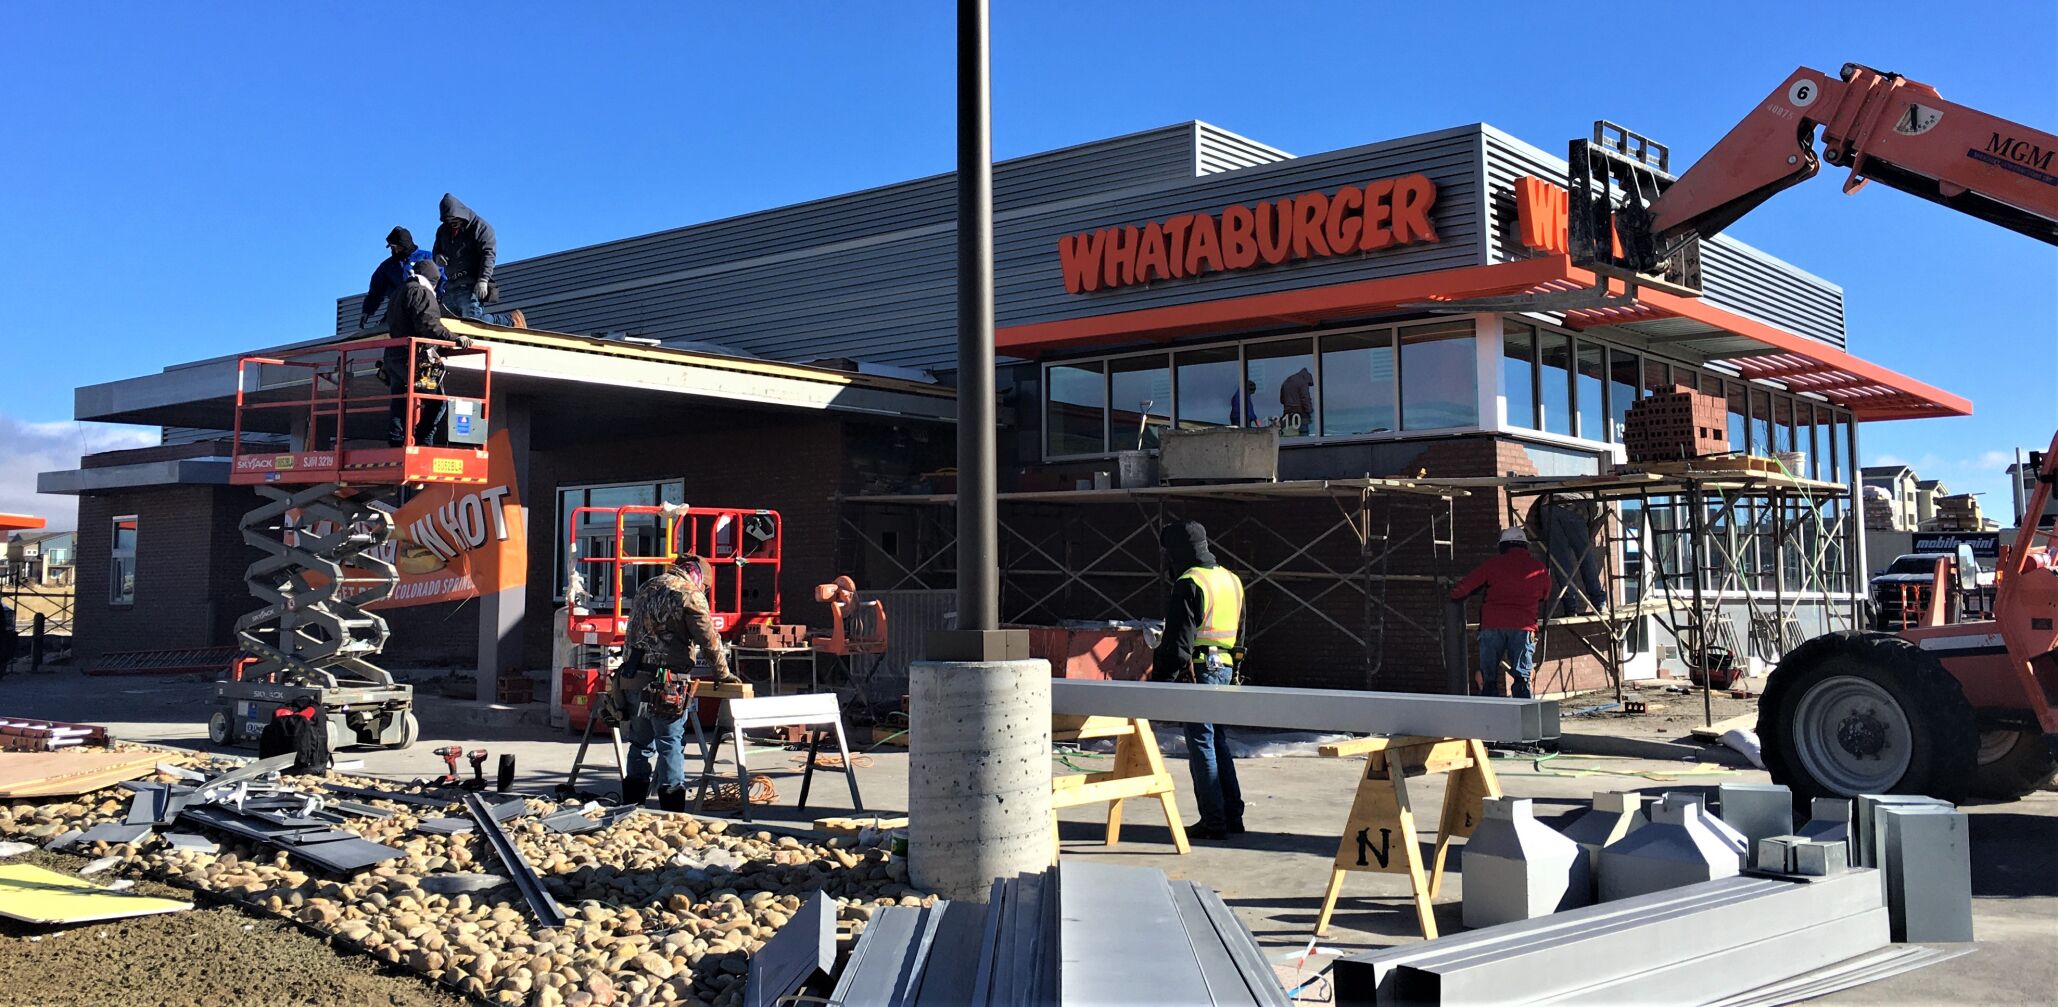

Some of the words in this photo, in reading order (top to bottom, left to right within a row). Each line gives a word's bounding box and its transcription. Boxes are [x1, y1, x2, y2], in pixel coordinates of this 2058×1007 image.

[1797, 86, 1810, 100] 6
[1985, 132, 2056, 170] MGM
[1058, 173, 1440, 295] WHATABURGER
[237, 457, 273, 470] SKYJACK
[439, 485, 509, 552] HOT
[395, 580, 440, 600] COLORADO
[1356, 827, 1392, 868] N
